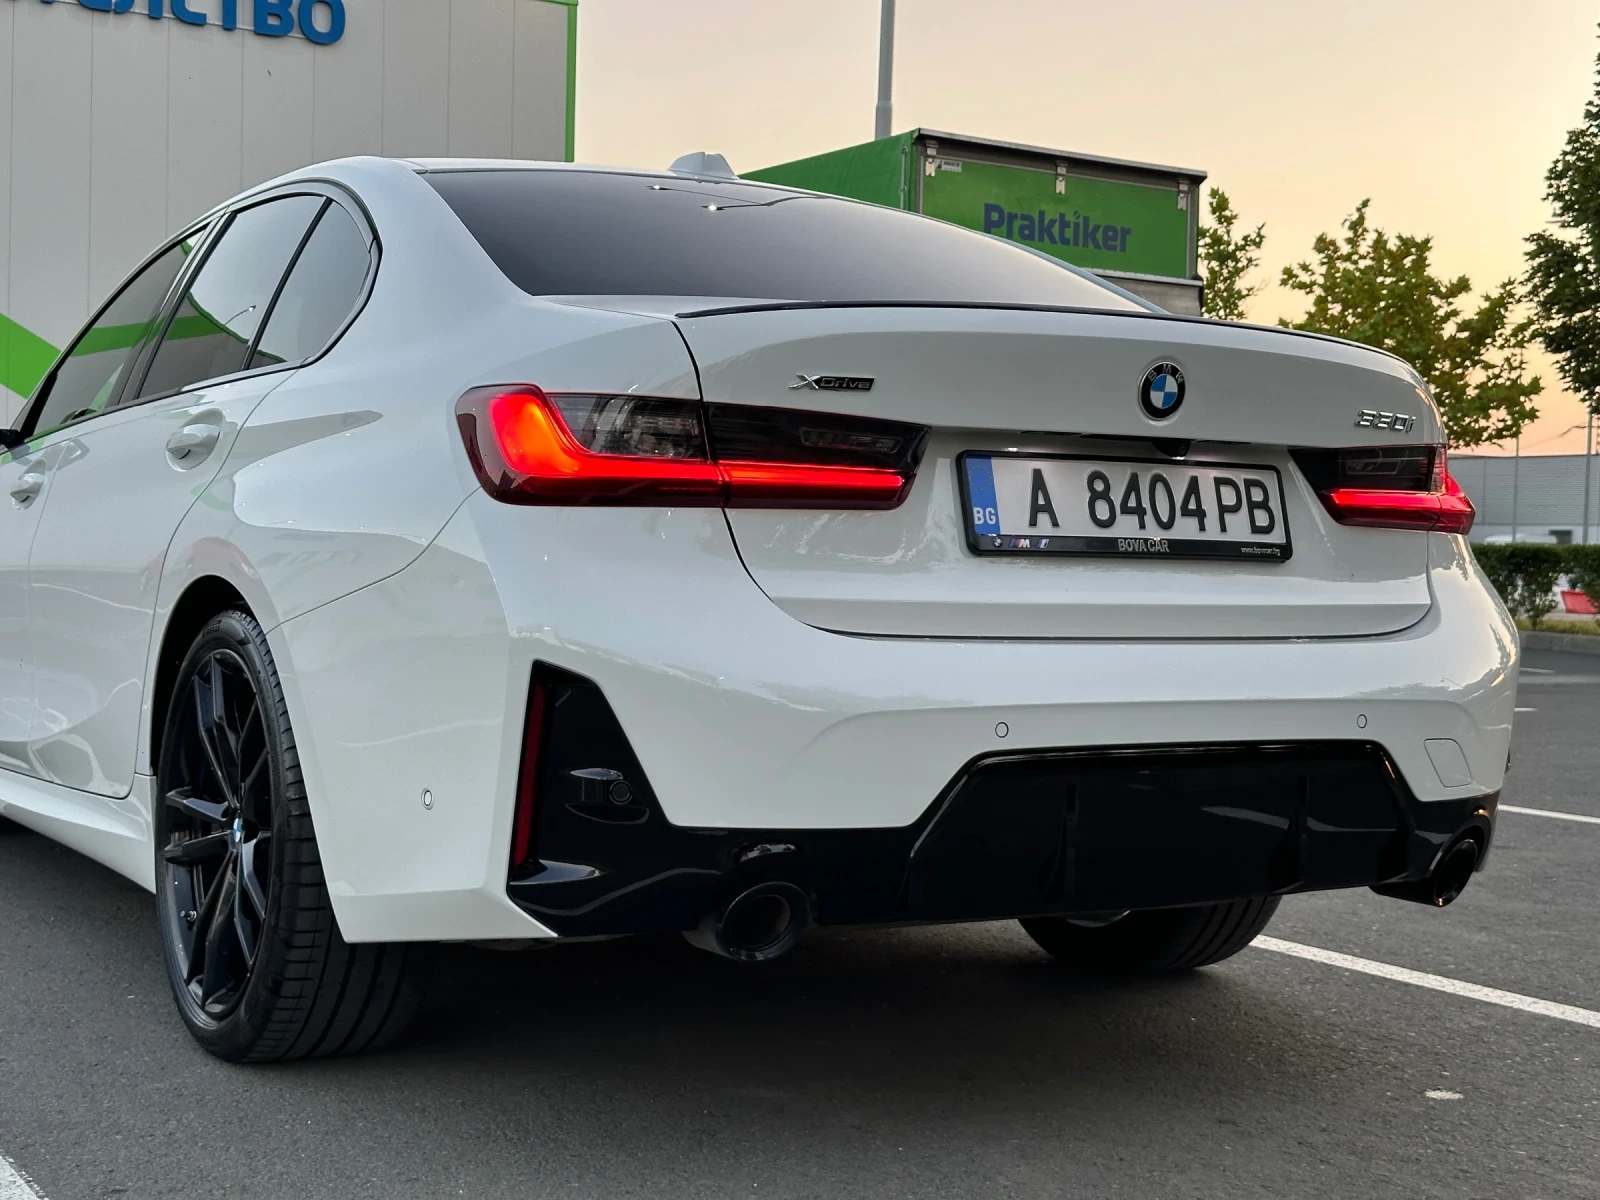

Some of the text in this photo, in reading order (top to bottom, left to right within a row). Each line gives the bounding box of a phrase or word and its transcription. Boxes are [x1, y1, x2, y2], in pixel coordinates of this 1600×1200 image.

[983, 203, 1131, 253] Praktiker
[1147, 364, 1184, 384] BMW
[1029, 469, 1059, 526] A
[973, 507, 996, 524] BG
[1118, 539, 1169, 552] BOVA CAR
